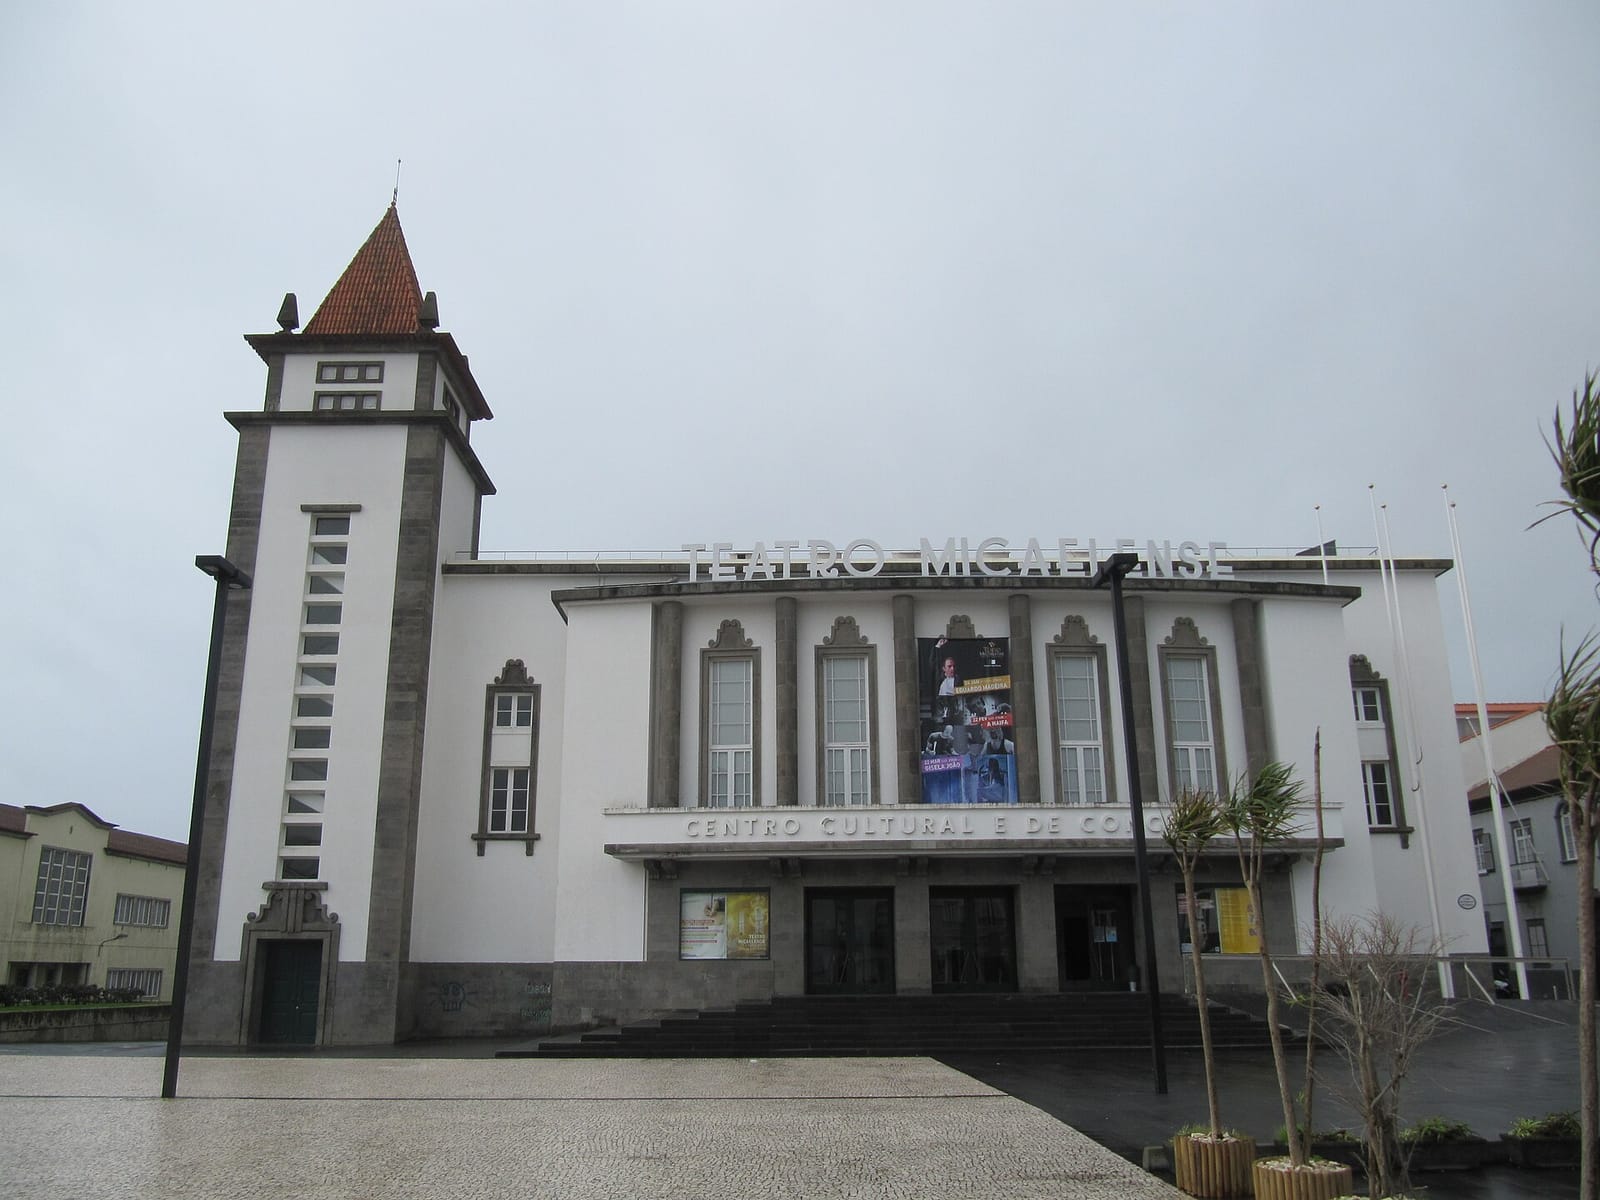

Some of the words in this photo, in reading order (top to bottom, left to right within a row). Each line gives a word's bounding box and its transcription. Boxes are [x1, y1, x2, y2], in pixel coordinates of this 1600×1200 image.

[682, 538, 885, 582] TEATRO
[686, 817, 801, 837] CENTRO
[821, 815, 974, 836] CULTURAL
[993, 816, 1008, 834] E
[1027, 815, 1061, 834] DE
